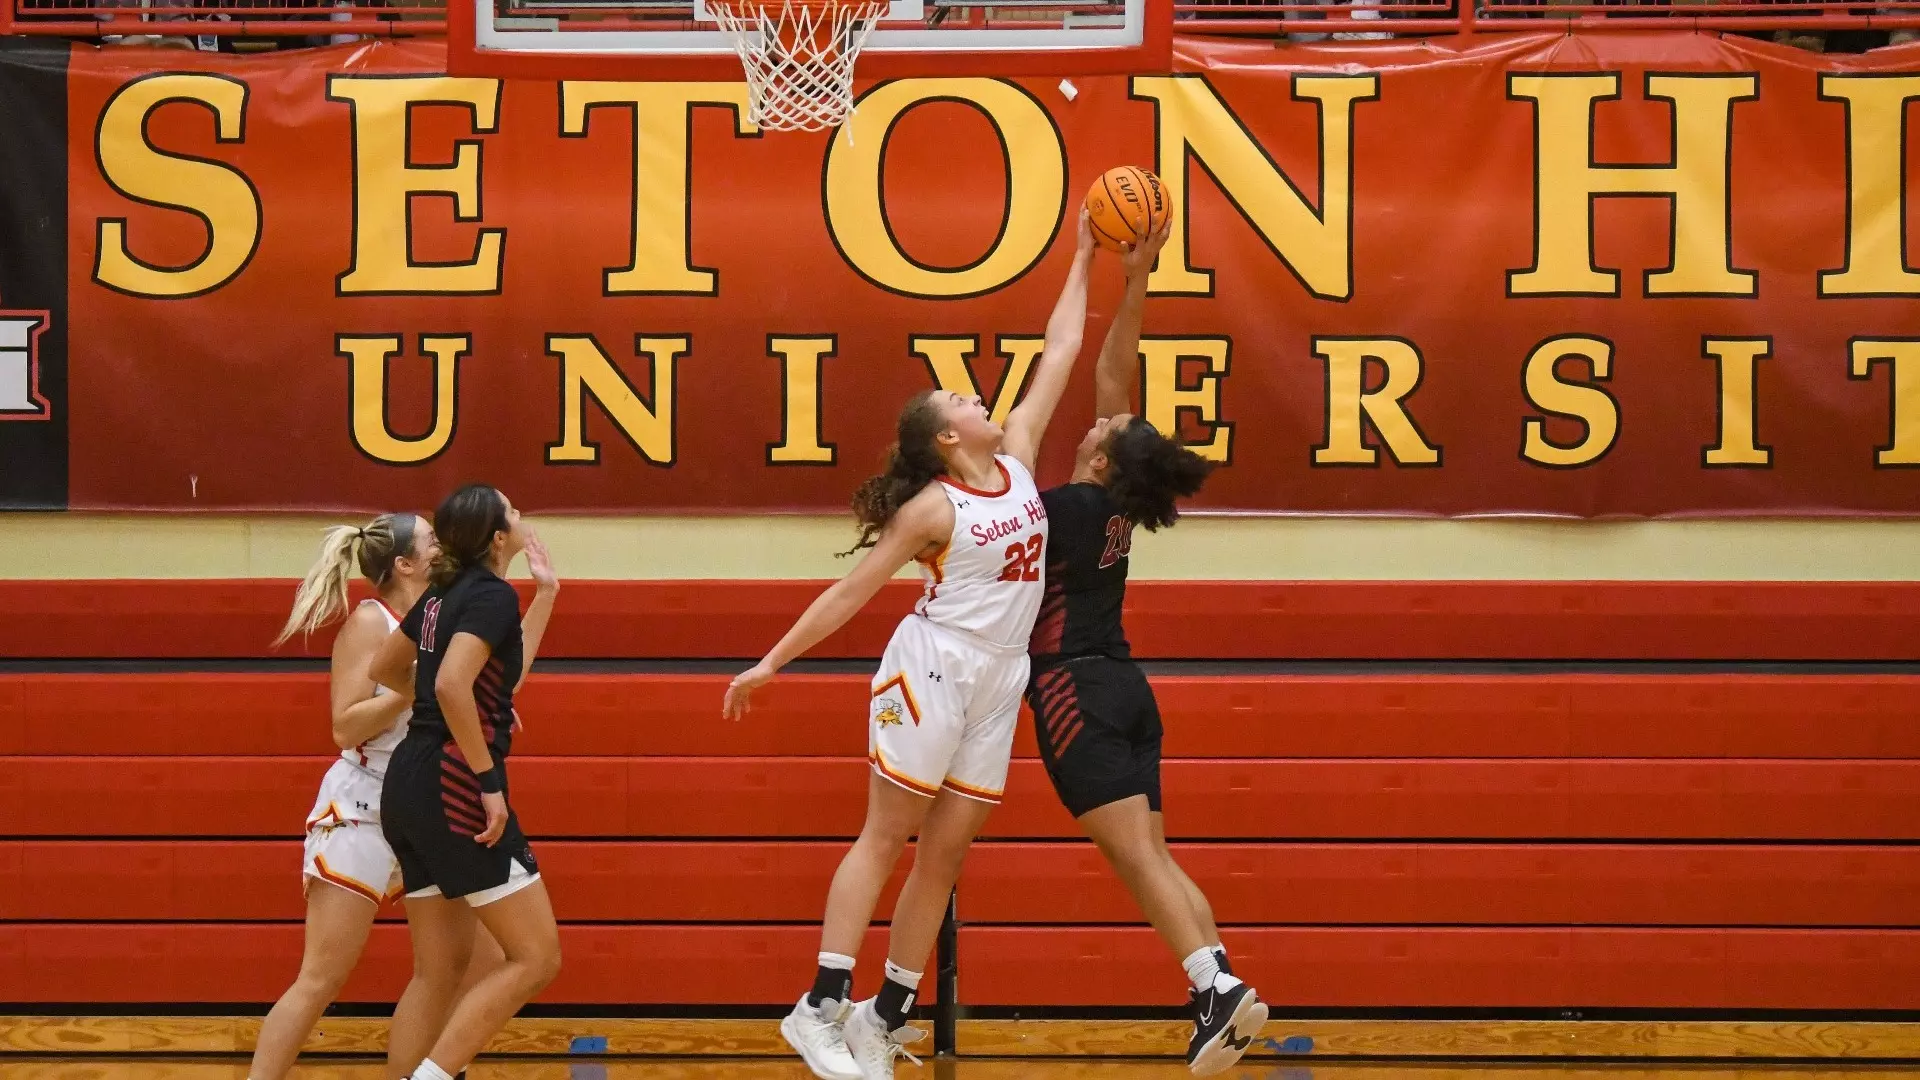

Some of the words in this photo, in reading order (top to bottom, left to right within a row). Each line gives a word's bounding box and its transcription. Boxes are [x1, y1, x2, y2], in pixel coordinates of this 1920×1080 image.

[92, 70, 1381, 302] SETON
[970, 515, 1023, 547] Seton
[997, 532, 1044, 582] 22
[1099, 513, 1133, 569] 20
[420, 596, 443, 653] 11
